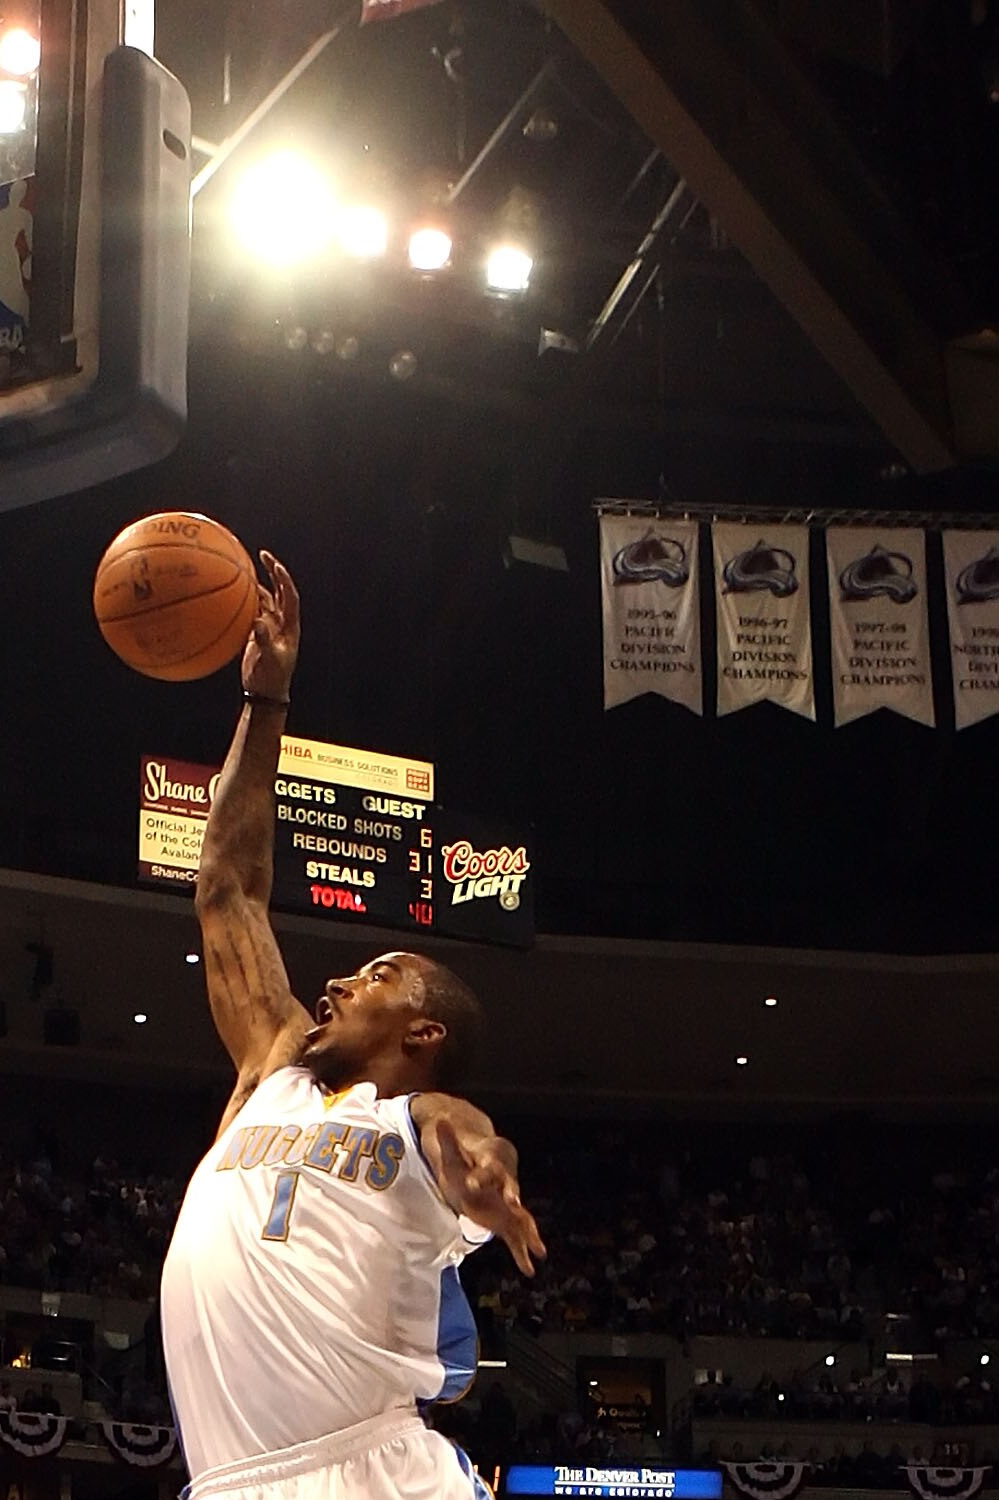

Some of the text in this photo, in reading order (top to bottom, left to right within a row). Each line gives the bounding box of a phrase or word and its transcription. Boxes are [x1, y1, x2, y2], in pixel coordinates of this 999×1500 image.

[621, 643, 686, 654] DIVISION
[737, 633, 791, 646] PACIFIC
[853, 639, 912, 651] PACIFIC
[609, 659, 695, 674] CHAMPIONS
[732, 651, 797, 663] DIVISION
[849, 656, 917, 668] DIVISION
[723, 667, 808, 680] CHAMPIONS
[144, 761, 209, 804] Shane
[362, 796, 426, 821] GUEST
[146, 817, 187, 833] Official
[277, 804, 403, 841] BLOCKED SHOTS
[145, 831, 157, 841] of
[160, 833, 178, 845] the
[293, 832, 387, 863] REBOUNDS
[441, 840, 530, 883] Coors
[306, 860, 376, 888] STEALS
[310, 884, 367, 913] TOTAL
[451, 873, 527, 906] LIGHT
[215, 1121, 406, 1191] NUGGETS
[261, 1172, 300, 1242] 1
[554, 1466, 676, 1485] THE DENVER POST
